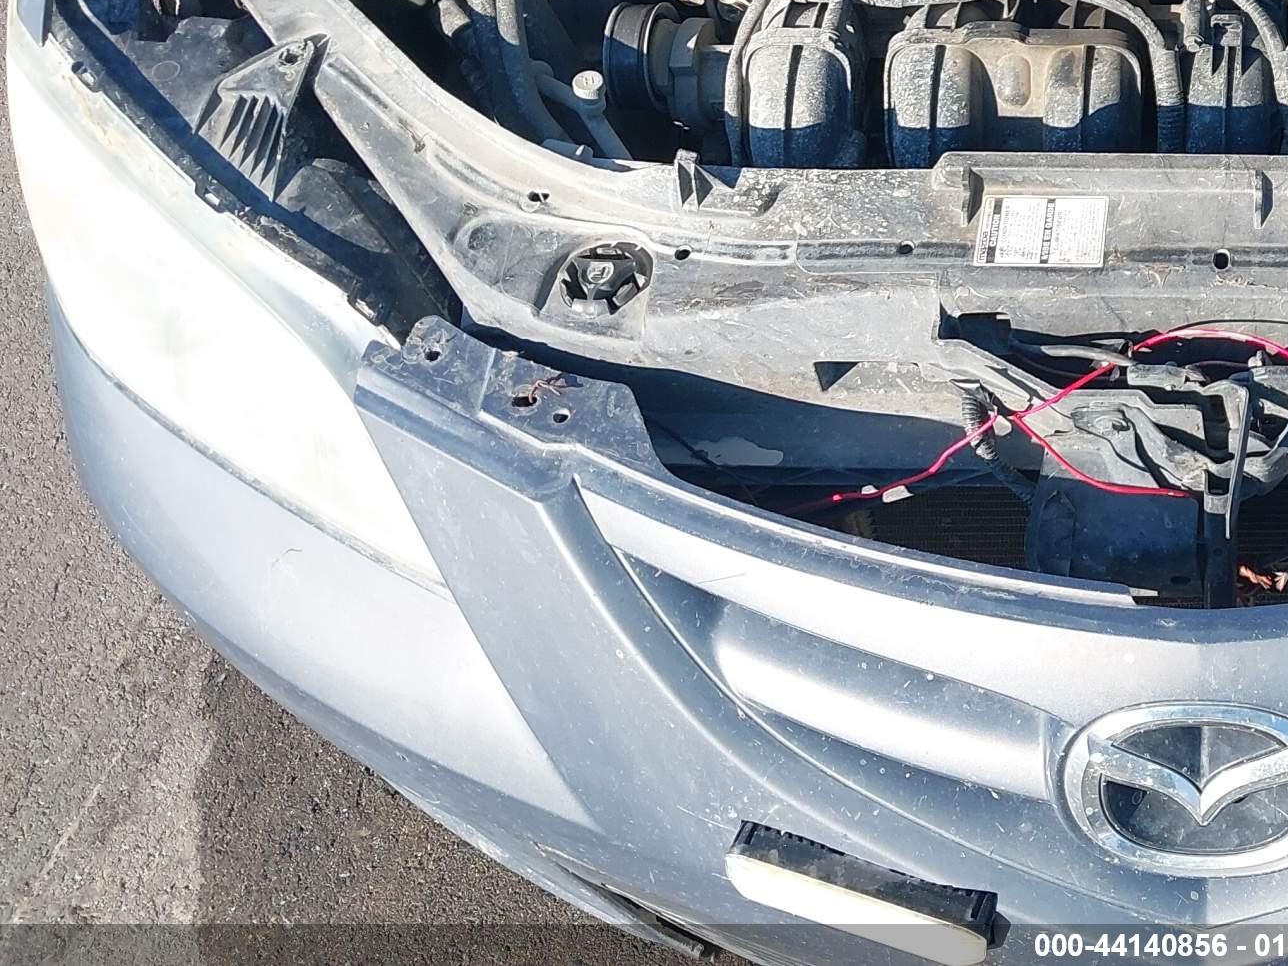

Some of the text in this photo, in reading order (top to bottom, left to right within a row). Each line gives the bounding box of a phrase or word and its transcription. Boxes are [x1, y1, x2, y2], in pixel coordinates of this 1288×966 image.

[1044, 202, 1055, 228] GARDE
[989, 214, 1001, 247] CAUTION
[1043, 229, 1052, 240] EN
[978, 231, 989, 261] mazda
